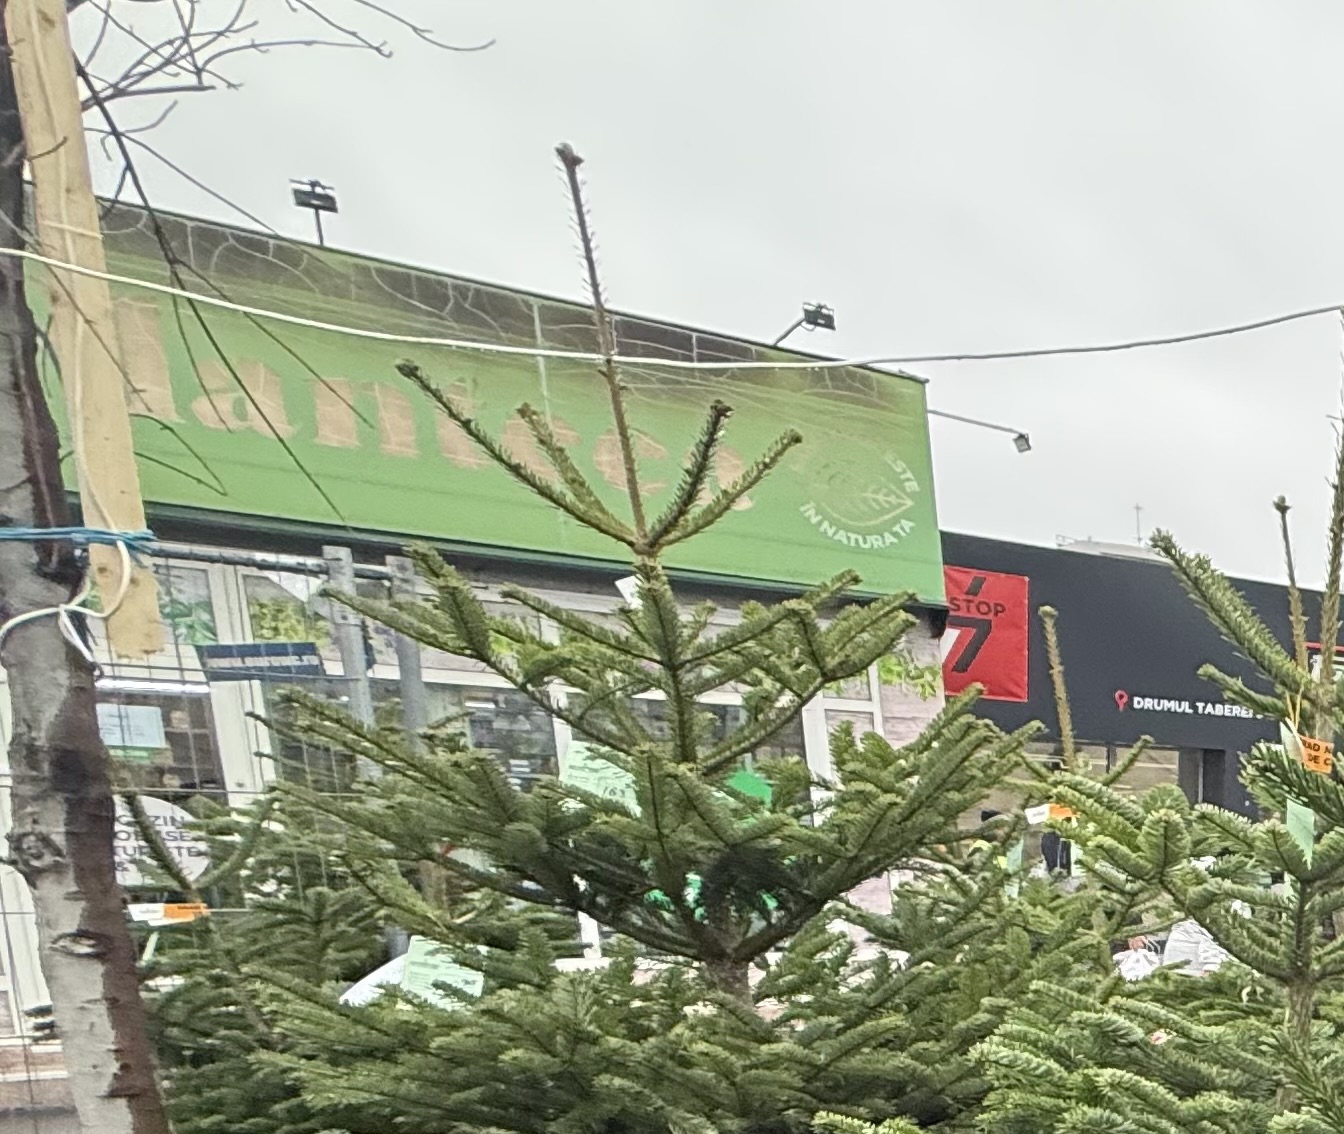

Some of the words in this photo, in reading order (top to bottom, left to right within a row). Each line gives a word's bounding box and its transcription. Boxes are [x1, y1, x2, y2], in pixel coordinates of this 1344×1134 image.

[819, 520, 899, 549] NATURA
[892, 519, 917, 538] TA
[949, 597, 1007, 618] STOP
[1132, 696, 1194, 714] DRUMUL
